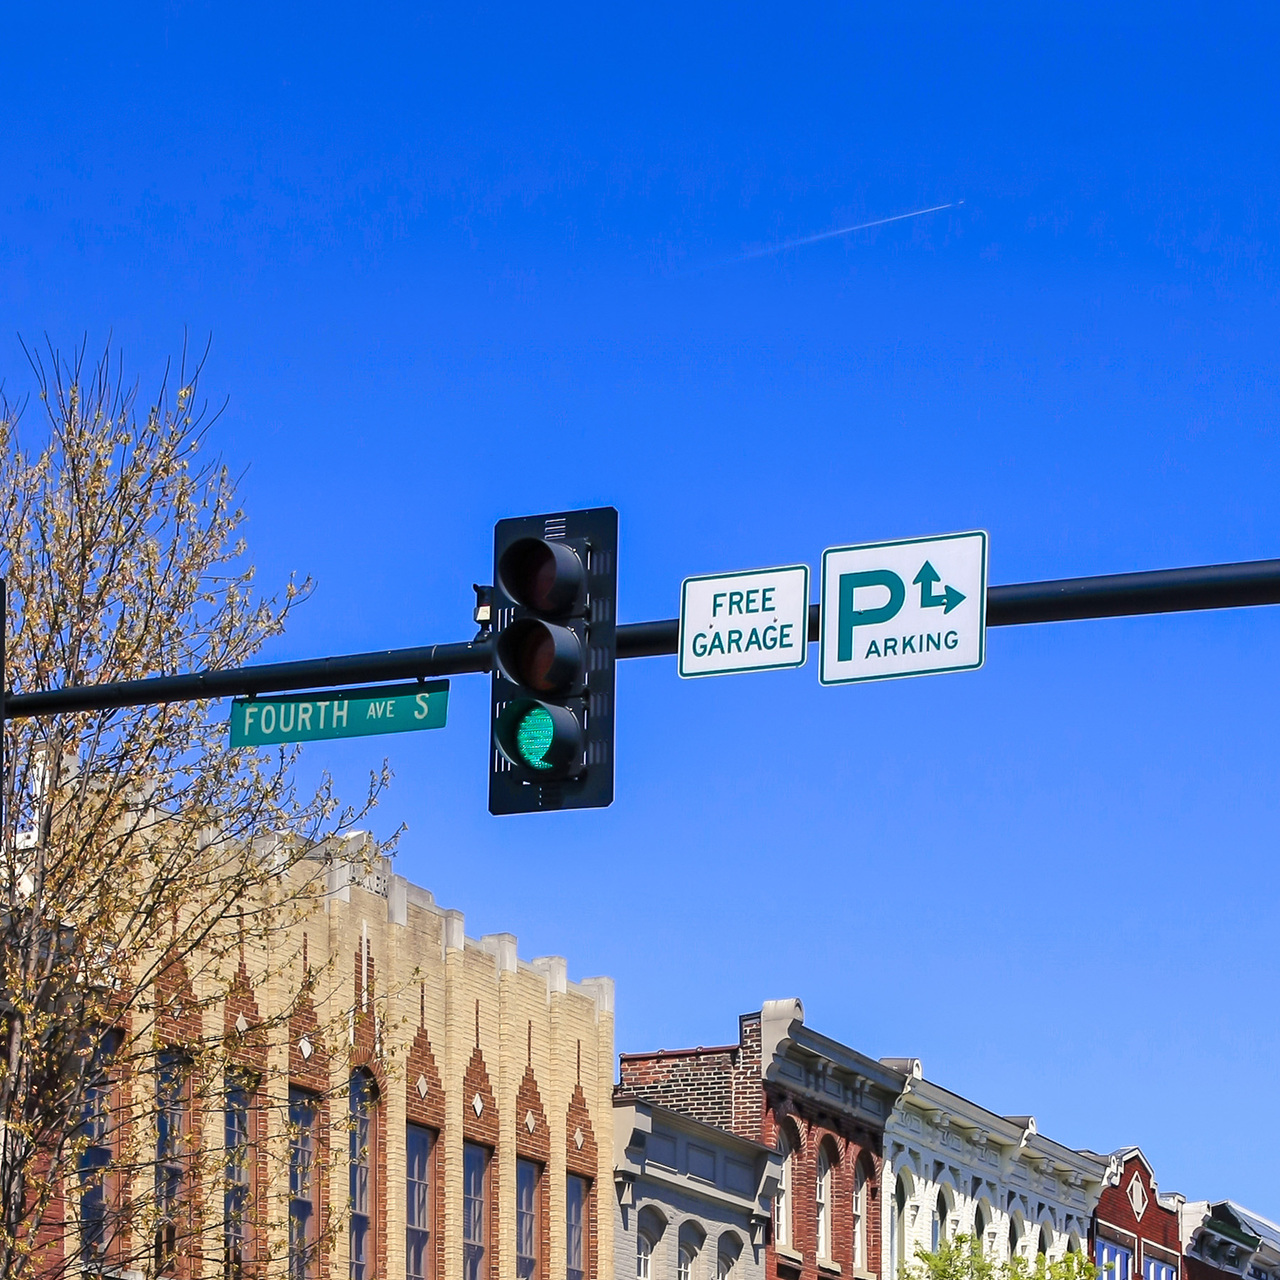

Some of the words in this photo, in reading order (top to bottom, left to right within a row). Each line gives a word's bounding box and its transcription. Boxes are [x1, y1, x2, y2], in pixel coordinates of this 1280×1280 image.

[711, 586, 776, 617] FREE
[691, 623, 794, 658] GARAGE
[244, 699, 349, 736] FOURTH
[366, 699, 396, 720] AVE
[413, 692, 430, 720] S
